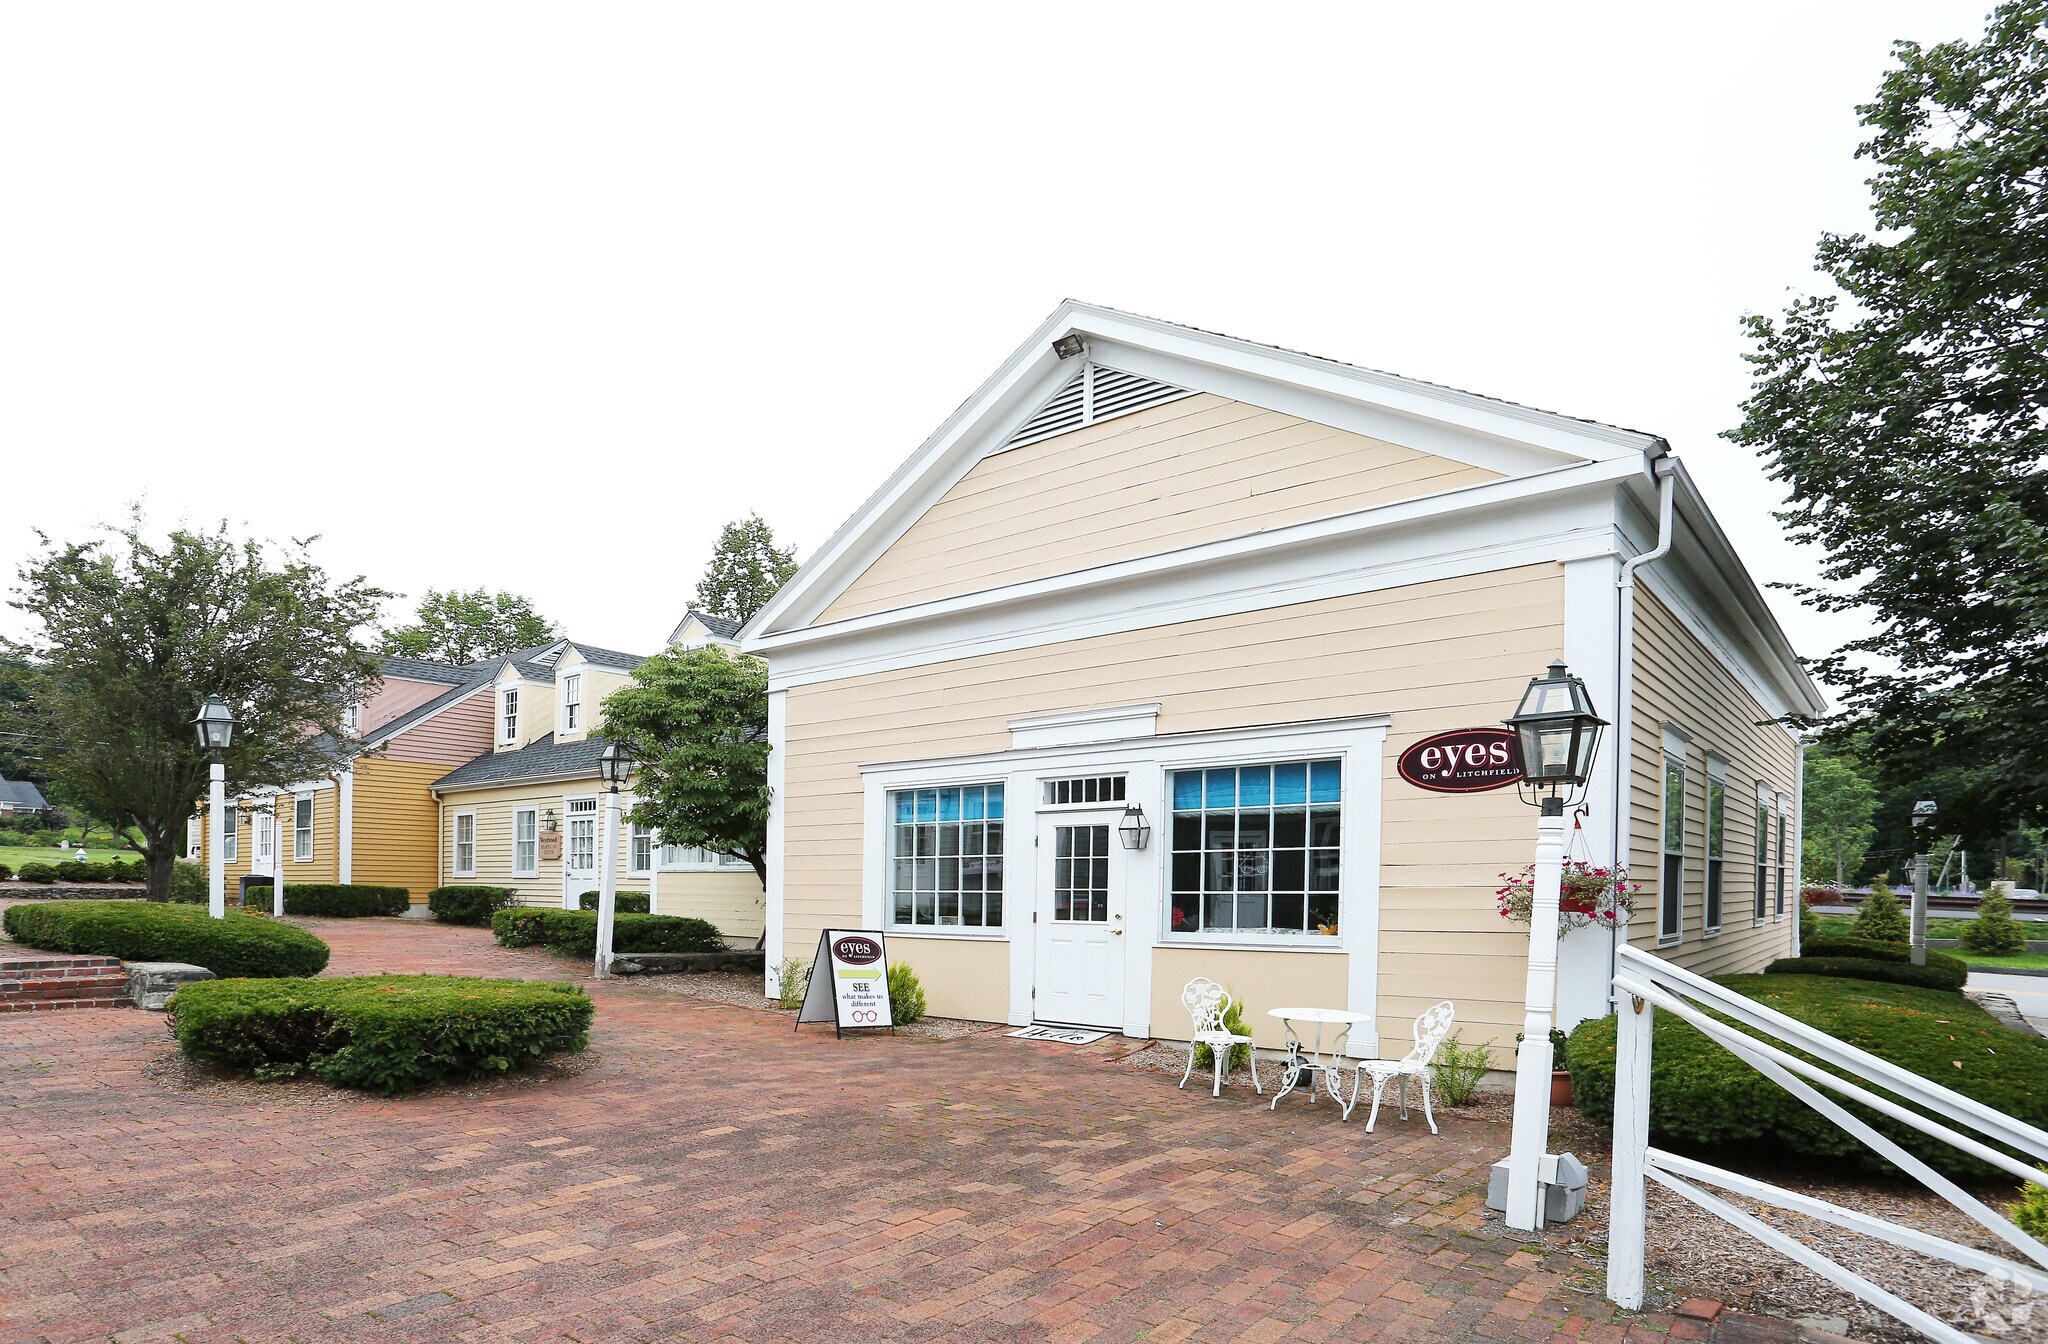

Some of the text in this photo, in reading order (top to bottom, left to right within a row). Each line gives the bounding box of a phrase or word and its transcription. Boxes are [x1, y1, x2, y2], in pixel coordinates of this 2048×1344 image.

[1420, 741, 1509, 777] eyes
[1456, 768, 1520, 778] LITCHFIELD
[841, 943, 870, 957] eyes
[852, 982, 870, 992] SEE
